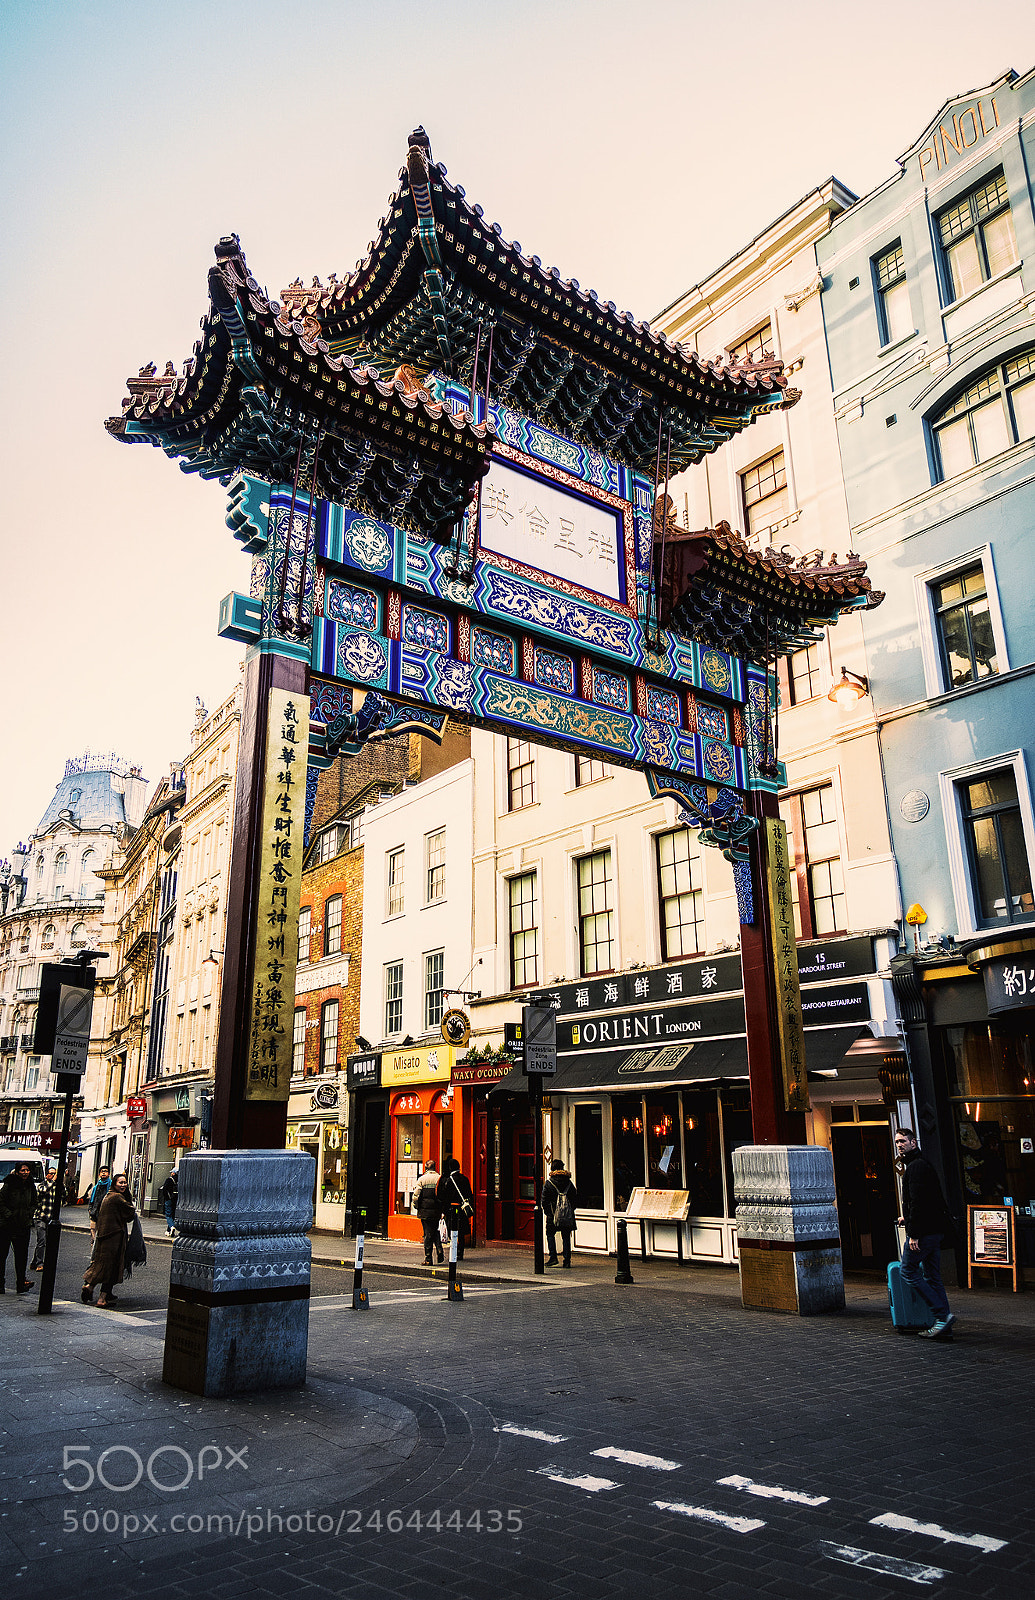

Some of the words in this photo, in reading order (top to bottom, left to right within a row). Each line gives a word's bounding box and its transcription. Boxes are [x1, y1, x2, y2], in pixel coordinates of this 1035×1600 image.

[918, 97, 1001, 182] PINOLI
[482, 484, 615, 569] 英倫呈祥
[815, 952, 826, 963] 15
[826, 961, 846, 971] STREET
[801, 1001, 827, 1010] SEAFOOD
[827, 997, 863, 1008] RESTAURANT
[583, 1014, 665, 1044] ORIENT
[665, 1020, 702, 1034] LONDON
[57, 1038, 87, 1048] Pedestrian
[63, 1048, 78, 1056] Zone
[56, 1058, 82, 1071] ENDS
[393, 1056, 421, 1071] Misato
[530, 1061, 553, 1070] ENDS
[453, 1070, 475, 1080] WAXY
[399, 1096, 421, 1110] みさと
